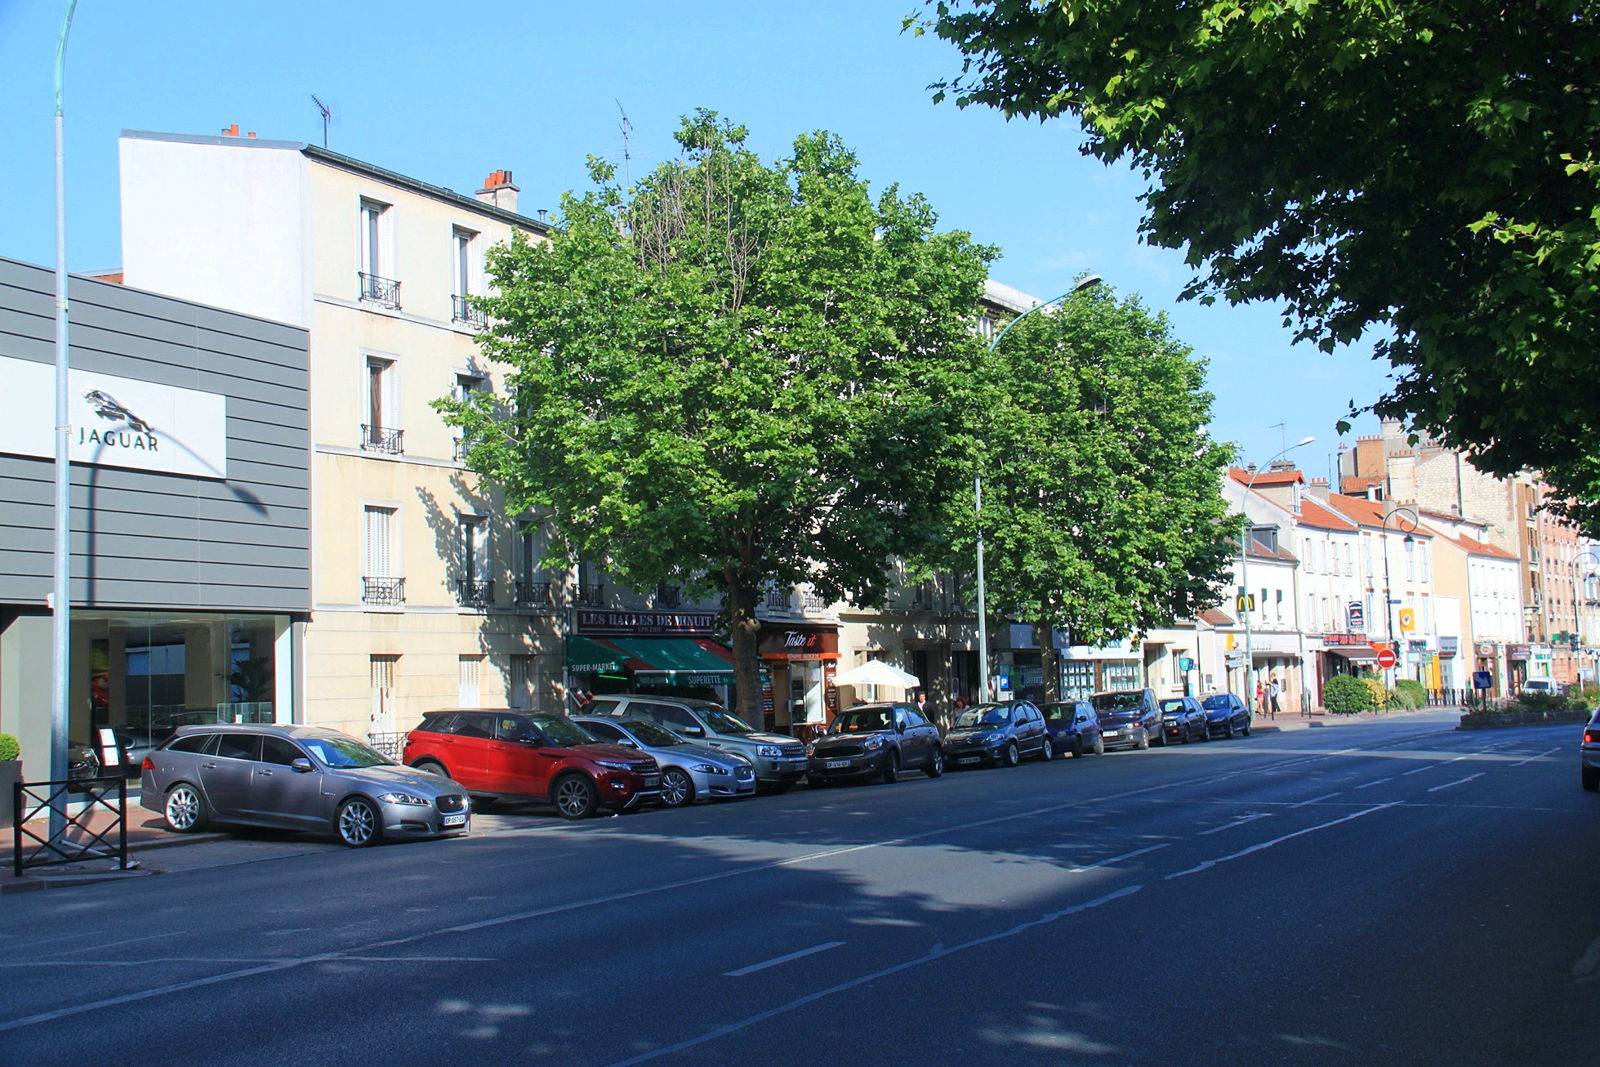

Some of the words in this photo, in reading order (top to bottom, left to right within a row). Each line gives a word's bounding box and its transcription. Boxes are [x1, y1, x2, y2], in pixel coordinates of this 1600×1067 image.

[79, 426, 159, 452] JAGUAR
[582, 613, 606, 625] LES
[609, 614, 654, 626] HALLES
[656, 615, 672, 626] DE
[674, 615, 712, 627] MINUIT
[784, 631, 806, 648] Taste
[806, 633, 817, 648] it
[571, 662, 616, 672] SUPER-MARKET
[688, 675, 721, 685] SUPERETTE
[1001, 678, 1007, 686] P
